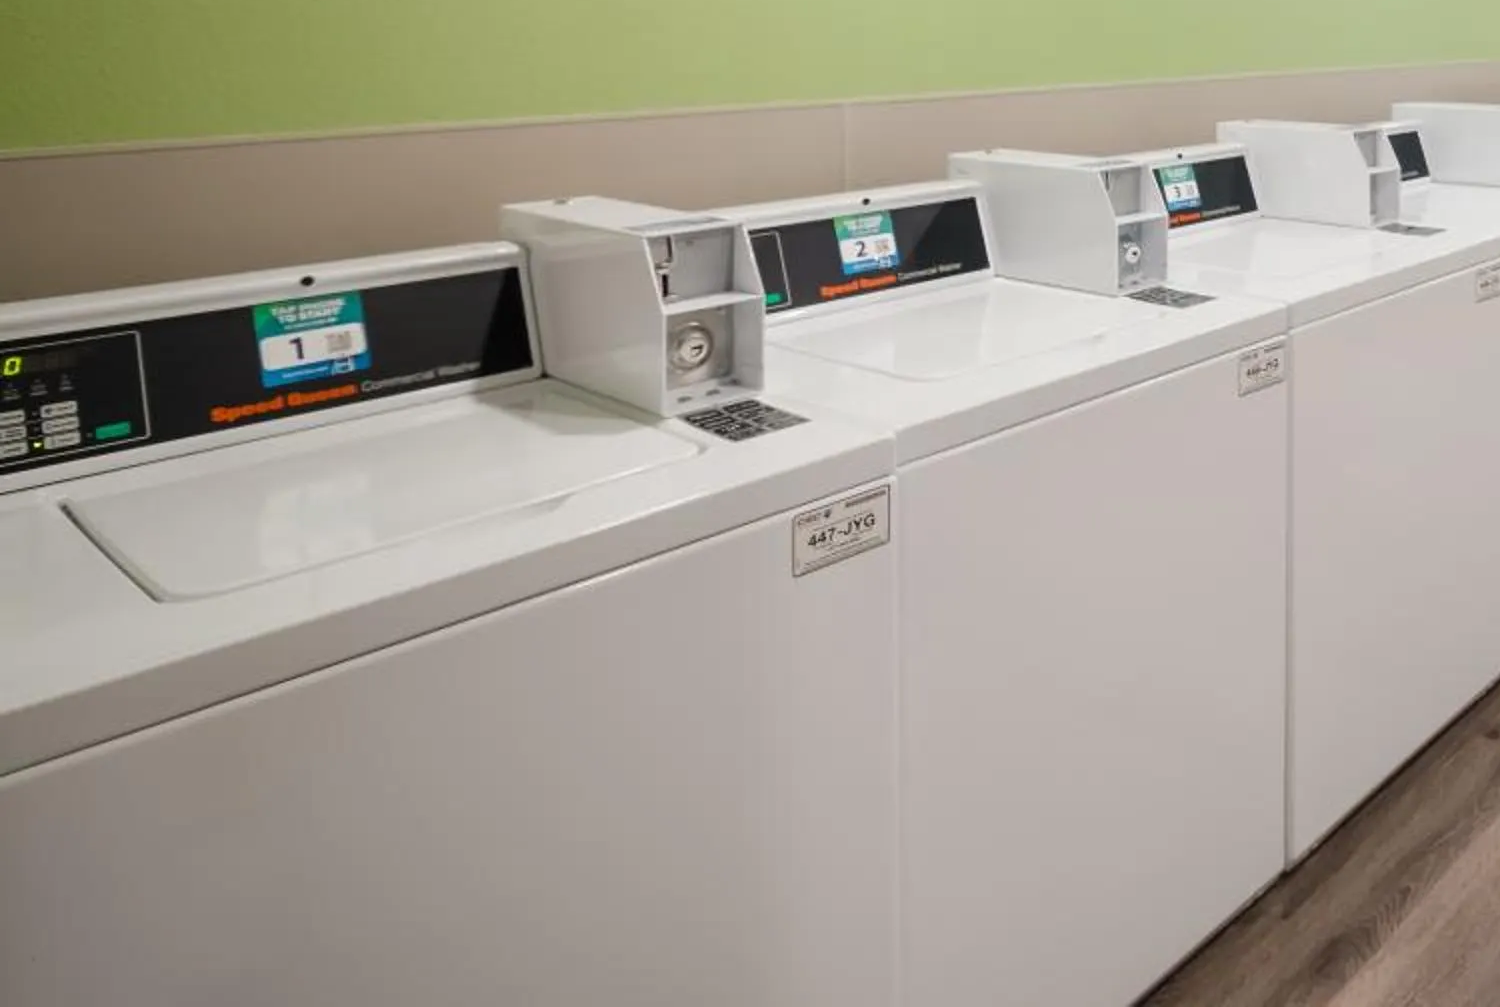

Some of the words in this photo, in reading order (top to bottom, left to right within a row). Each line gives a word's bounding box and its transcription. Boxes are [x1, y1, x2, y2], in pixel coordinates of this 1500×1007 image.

[855, 240, 867, 257] 2
[288, 336, 306, 361] 1
[211, 395, 284, 422] Speed
[287, 384, 357, 406] Queen
[808, 513, 875, 546] 447-JYG
